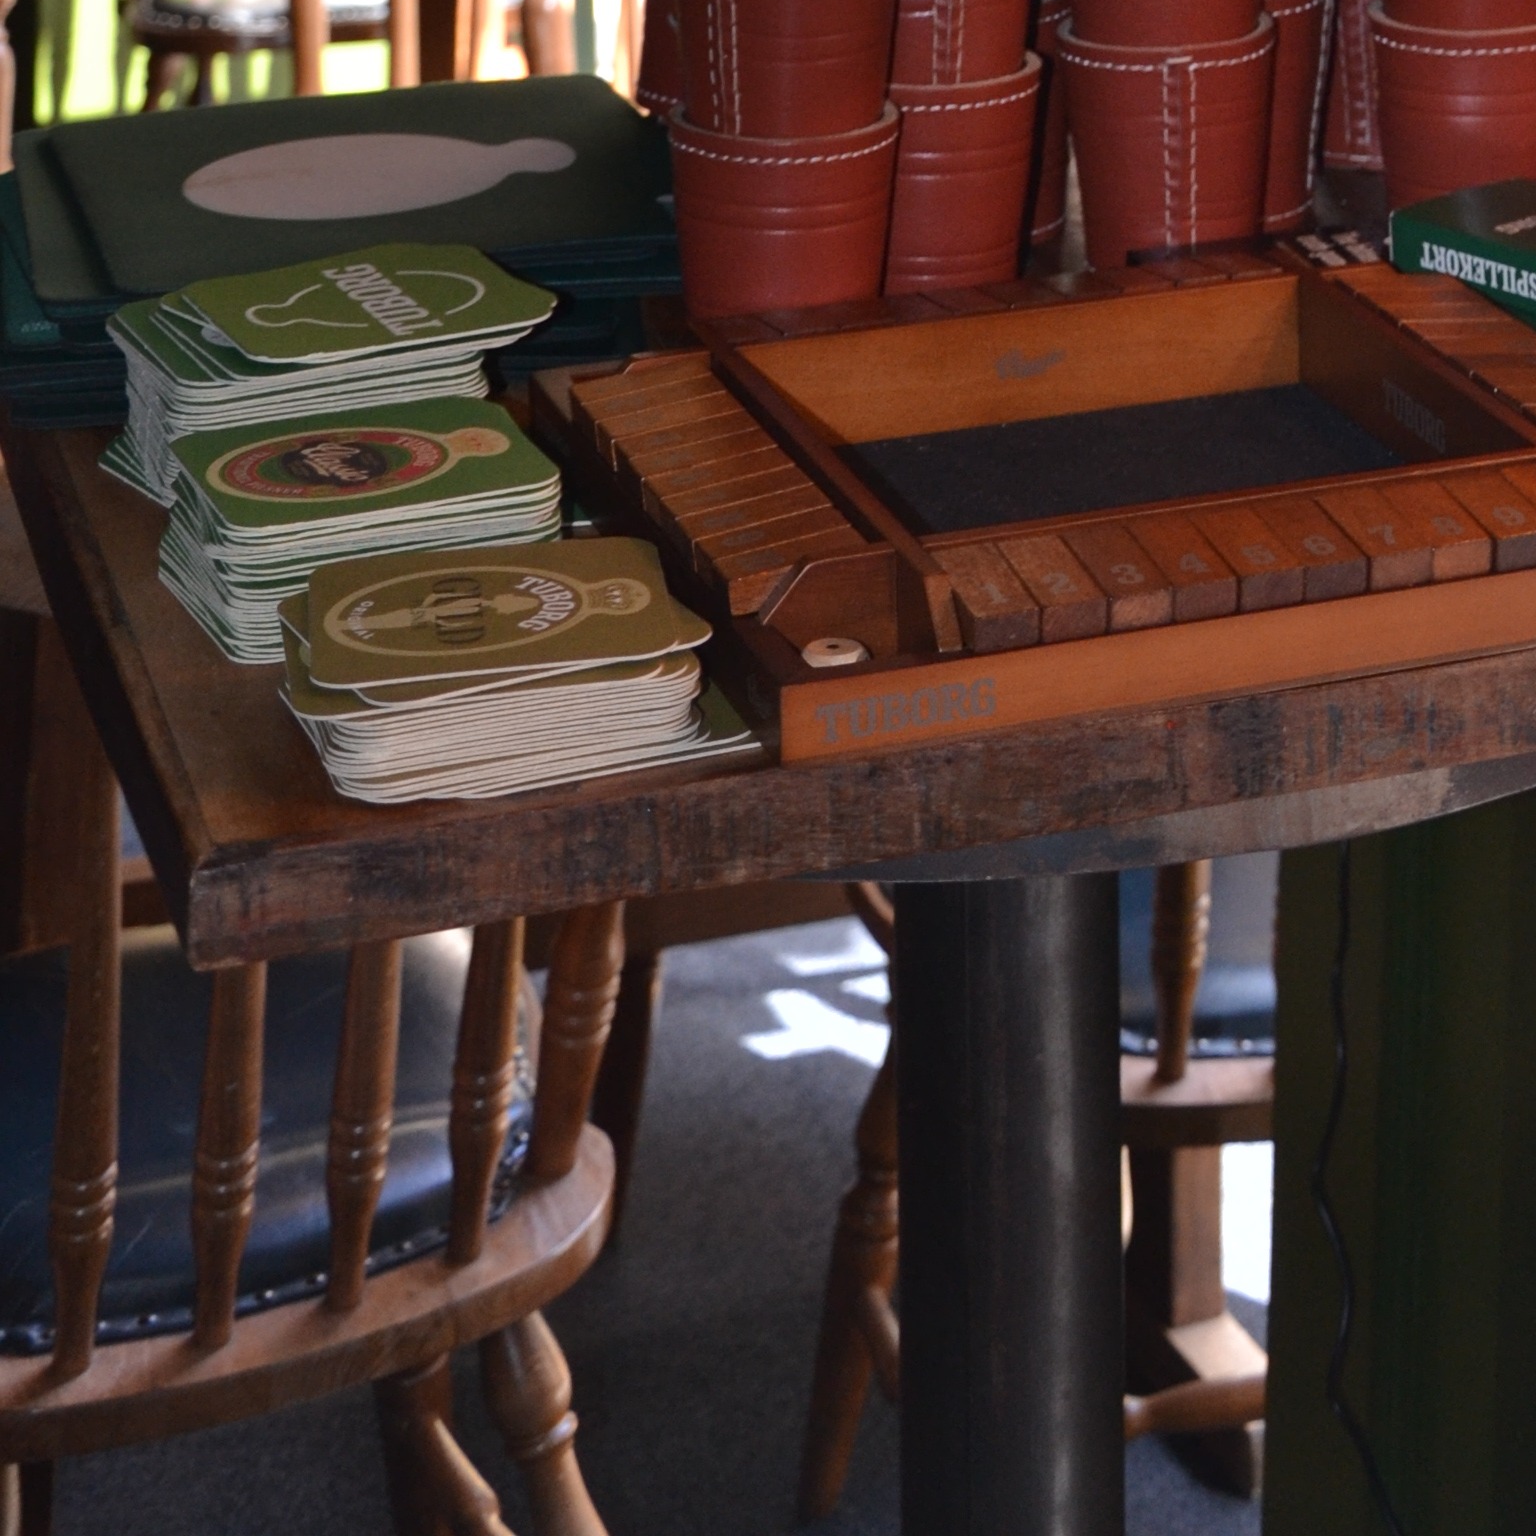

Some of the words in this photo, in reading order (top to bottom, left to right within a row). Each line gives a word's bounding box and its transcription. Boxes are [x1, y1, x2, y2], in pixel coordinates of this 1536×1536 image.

[321, 262, 444, 337] TUBORG
[1109, 563, 1146, 586] 3
[1178, 552, 1212, 575] 4
[1367, 522, 1398, 547] 7
[514, 575, 576, 632] TUBORG
[815, 675, 998, 745] TUBORG
